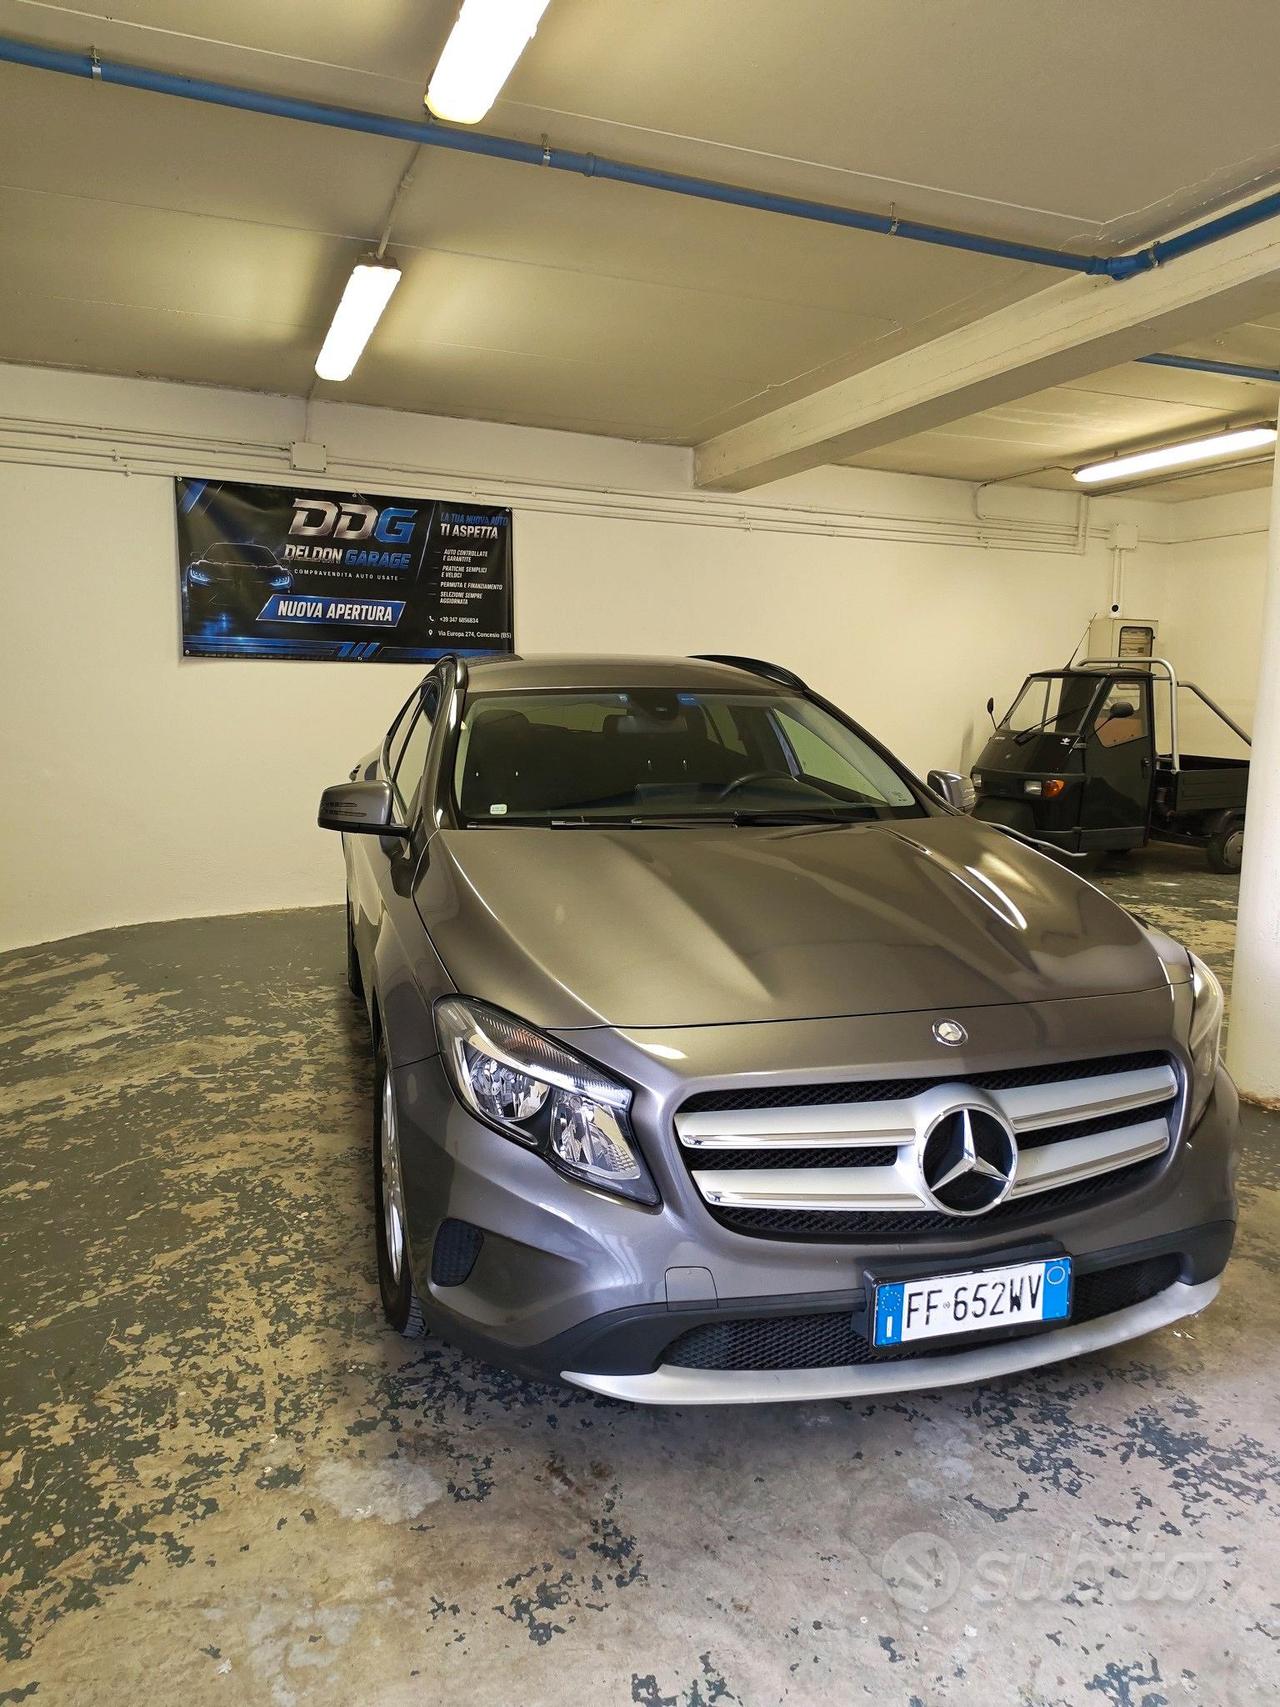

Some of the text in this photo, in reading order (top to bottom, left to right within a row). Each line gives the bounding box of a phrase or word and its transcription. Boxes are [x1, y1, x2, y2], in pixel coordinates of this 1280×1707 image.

[288, 498, 418, 543] DDG
[440, 512, 509, 526] LA TUA NUOVA AUTO
[440, 523, 498, 539] TI ASPETTA
[284, 544, 412, 569] DELDON GARAGE
[294, 568, 352, 578] COMPRAVENDITA
[278, 600, 392, 621] NUOVA APERTURA
[907, 1273, 1041, 1328] FF 652WV
